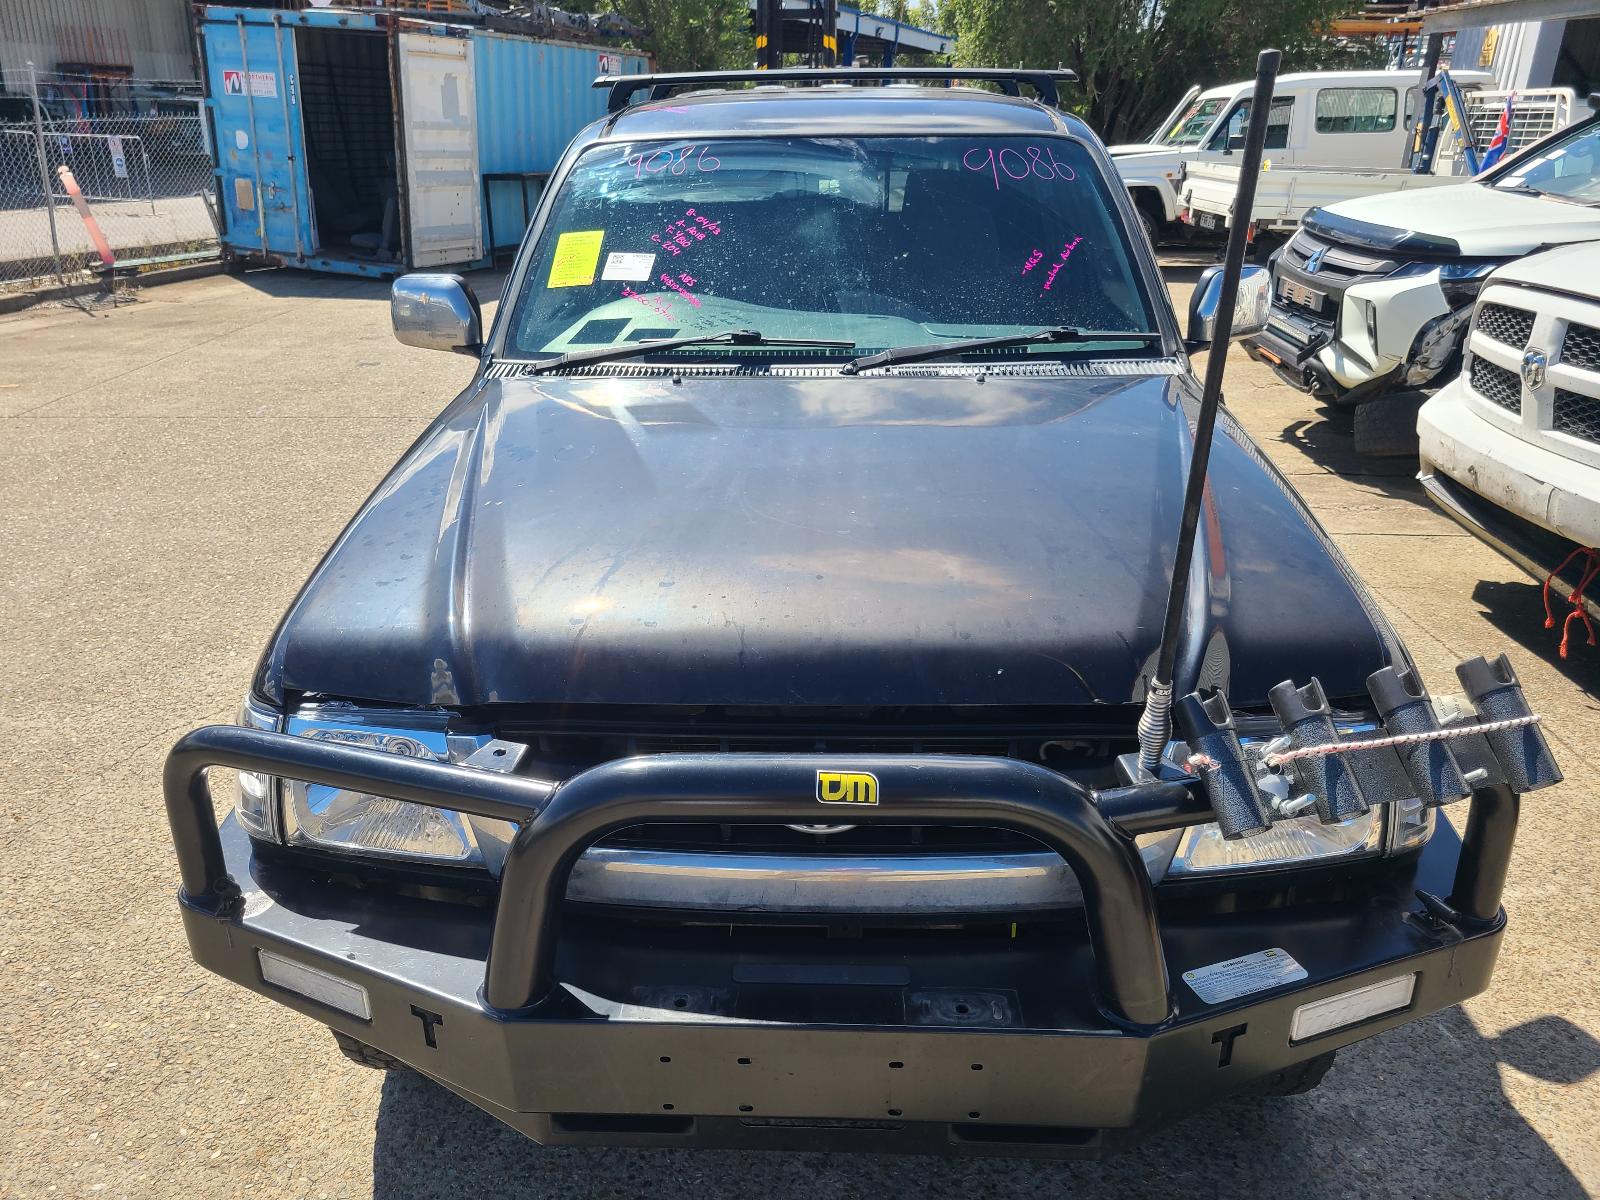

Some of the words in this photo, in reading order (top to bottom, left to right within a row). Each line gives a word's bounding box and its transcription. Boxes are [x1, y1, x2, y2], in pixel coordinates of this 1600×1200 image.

[628, 144, 721, 179] 9086
[963, 146, 1075, 191] 9086
[695, 216, 721, 235] 04/03
[678, 272, 697, 287] ABS
